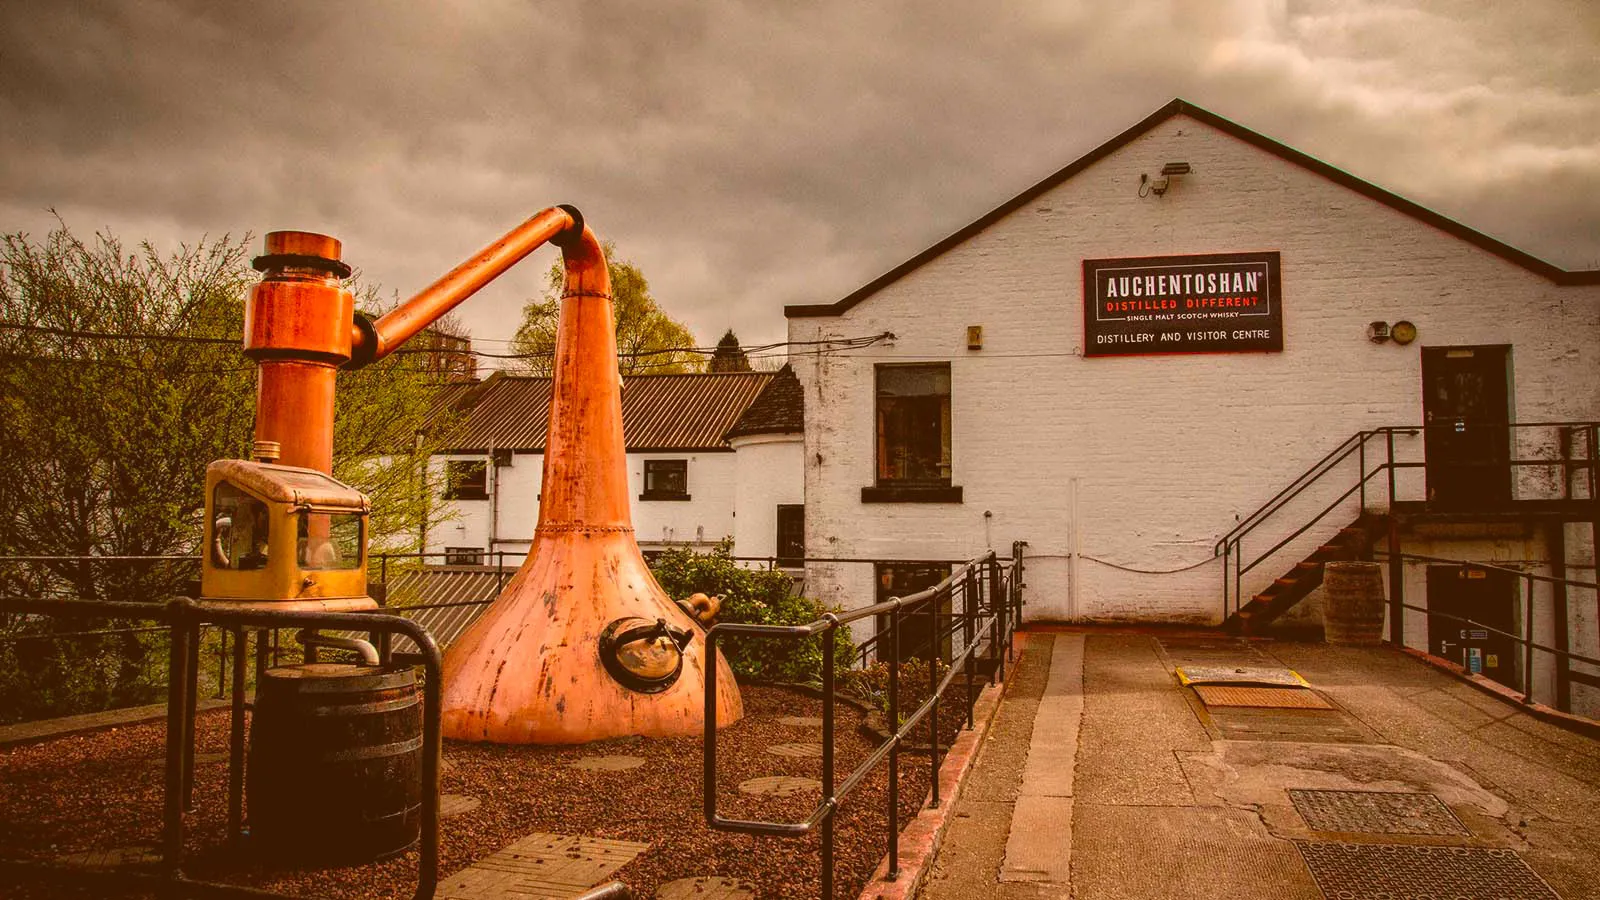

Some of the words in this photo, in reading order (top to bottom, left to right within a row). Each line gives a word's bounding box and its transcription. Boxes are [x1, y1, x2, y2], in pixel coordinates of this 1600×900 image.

[1107, 271, 1258, 298] AUCHENTOSHAN
[1106, 299, 1177, 312] DISTILLED
[1186, 296, 1258, 309] DIFFERENT
[1126, 314, 1153, 322] SINGLE
[1177, 312, 1208, 320] SCOTCH
[1209, 311, 1239, 319] WHISKY
[1097, 333, 1154, 344] DISTILLERY
[1160, 332, 1181, 342] AND
[1186, 331, 1227, 341] VISITOR
[1232, 329, 1270, 339] CENTRE
